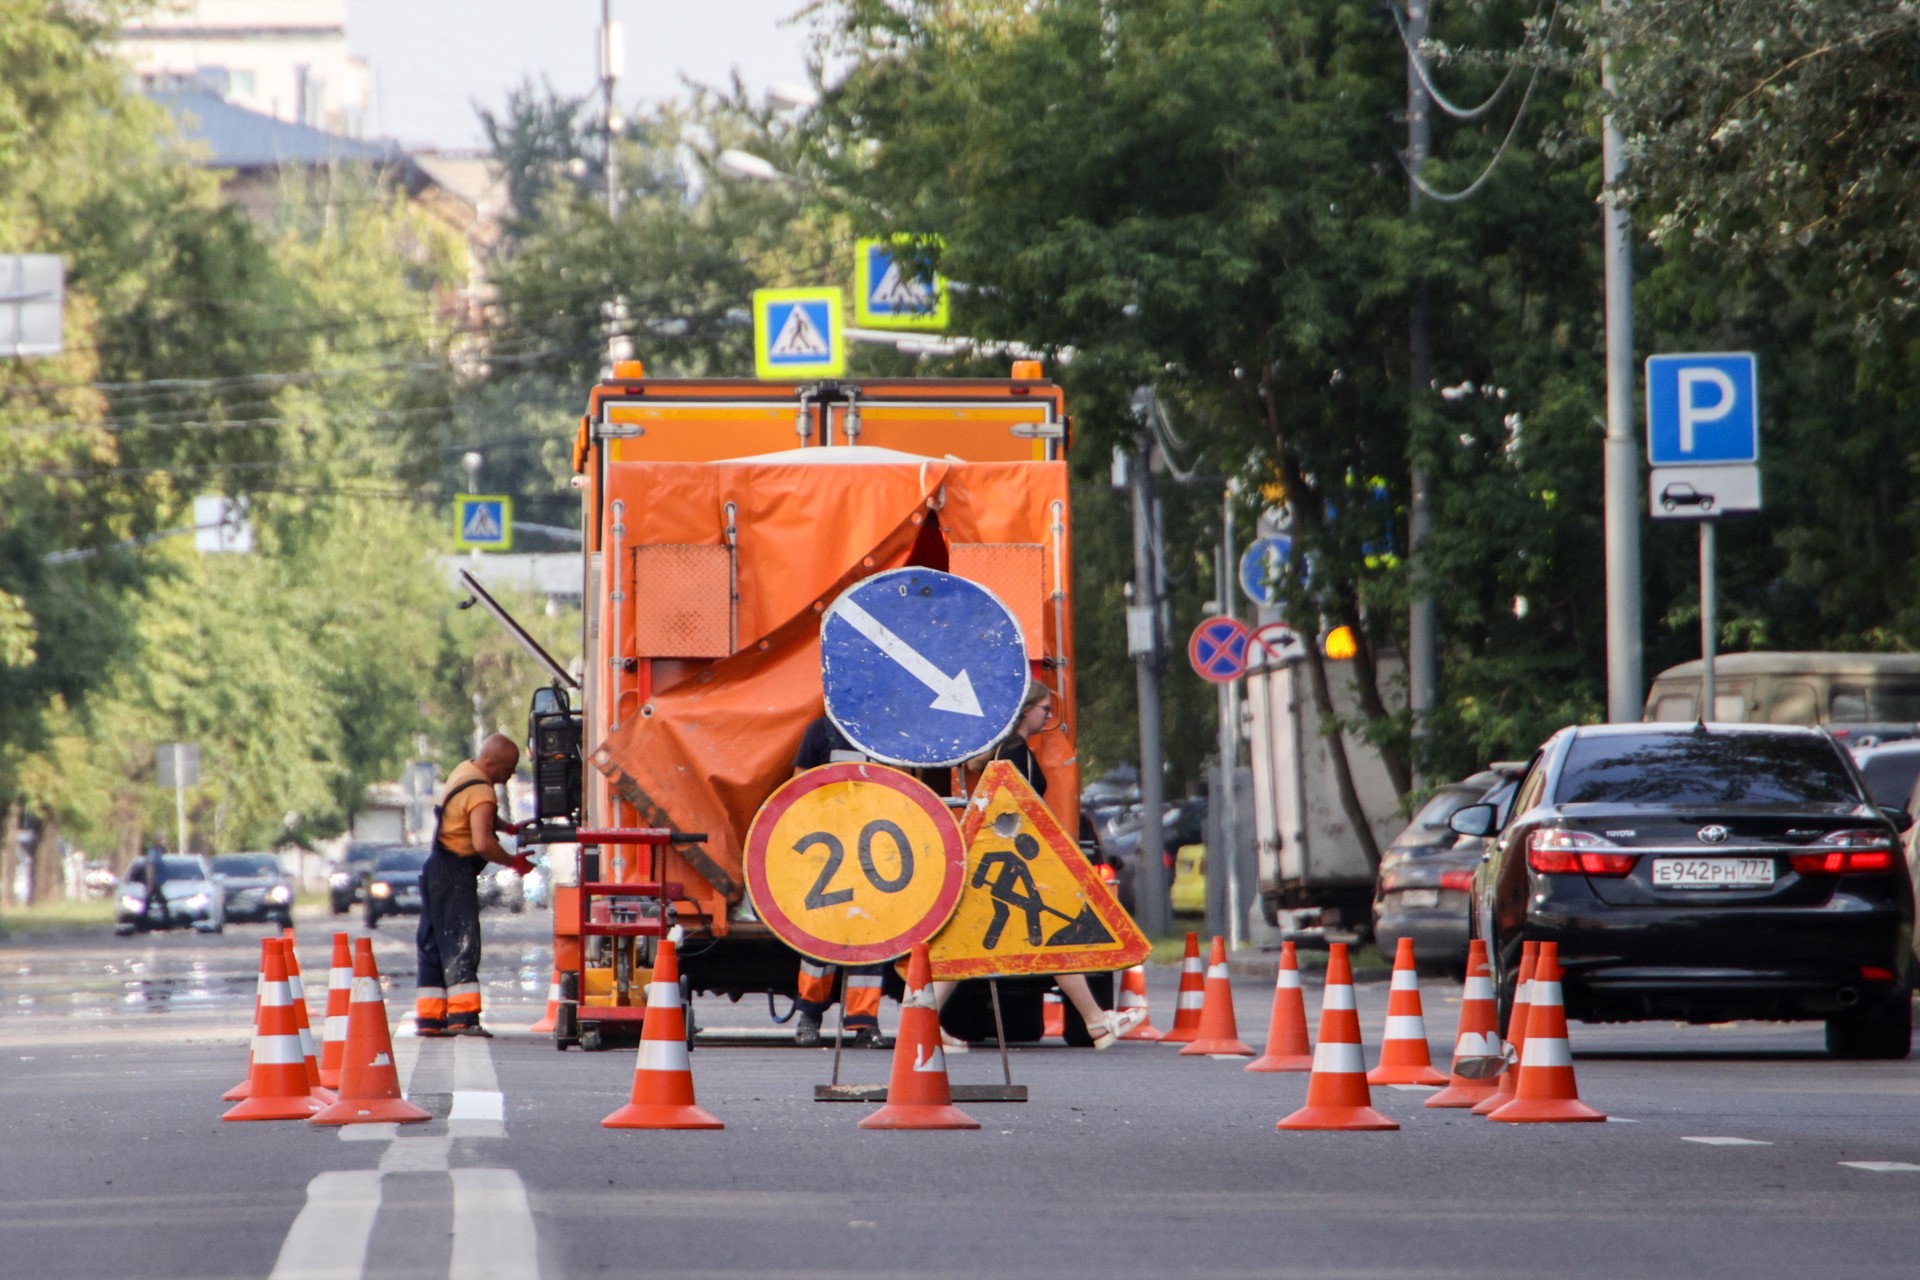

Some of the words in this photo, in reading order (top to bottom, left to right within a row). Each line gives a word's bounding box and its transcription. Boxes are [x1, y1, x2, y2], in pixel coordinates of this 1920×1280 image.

[1677, 367, 1735, 452] P
[792, 819, 915, 911] 20
[1605, 830, 1636, 838] TOYOTA
